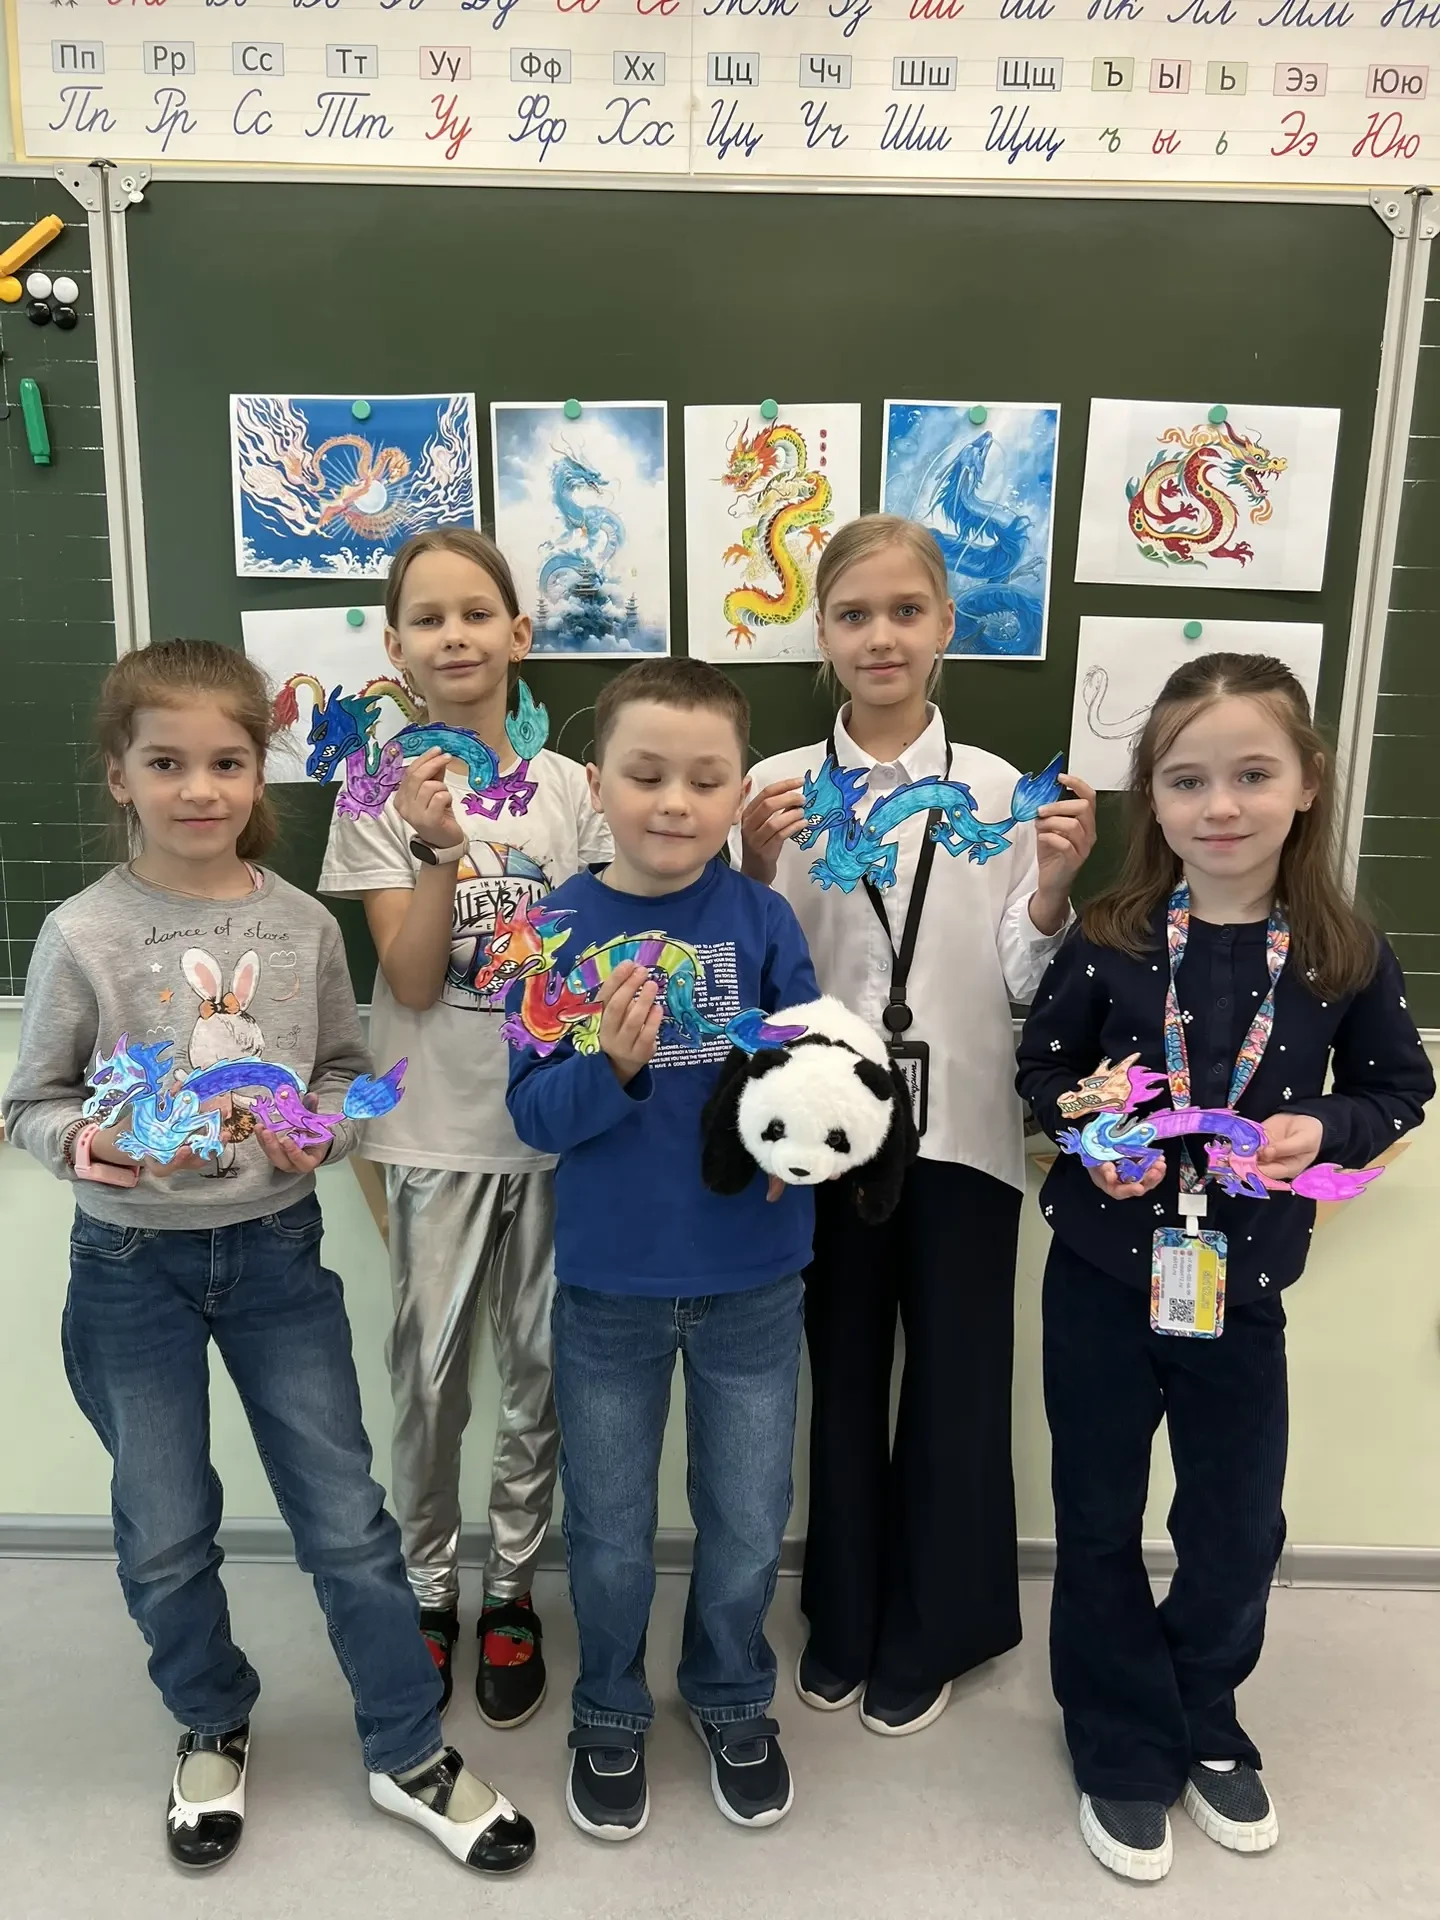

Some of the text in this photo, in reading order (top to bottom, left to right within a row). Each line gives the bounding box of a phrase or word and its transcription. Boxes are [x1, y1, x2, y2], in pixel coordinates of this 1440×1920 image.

[60, 44, 95, 69] Пп
[153, 45, 186, 76] Рр
[241, 46, 273, 72] Сс
[335, 48, 368, 75] Тт
[428, 50, 461, 82] Уу
[520, 52, 562, 83] Фф
[623, 55, 656, 81] Хх
[714, 56, 753, 85] Цц
[809, 57, 842, 84] Чч
[900, 60, 950, 86] Шш
[1003, 60, 1056, 90] Щщ
[1285, 67, 1319, 92] Ээ
[1372, 67, 1423, 95] Юю
[48, 85, 117, 132] Пп
[145, 87, 197, 152] Рр
[233, 88, 273, 135] Сс
[304, 91, 394, 139] Тт
[425, 93, 472, 160] Уу
[508, 93, 567, 162] Фф
[597, 97, 675, 146] Хх
[706, 98, 763, 160] Цц
[800, 100, 849, 148] Чч
[880, 103, 952, 151] Шш
[985, 105, 1065, 164] Щщ
[1271, 110, 1318, 157] Ээ
[1352, 111, 1421, 159] Юю
[144, 917, 290, 946] dance of stars
